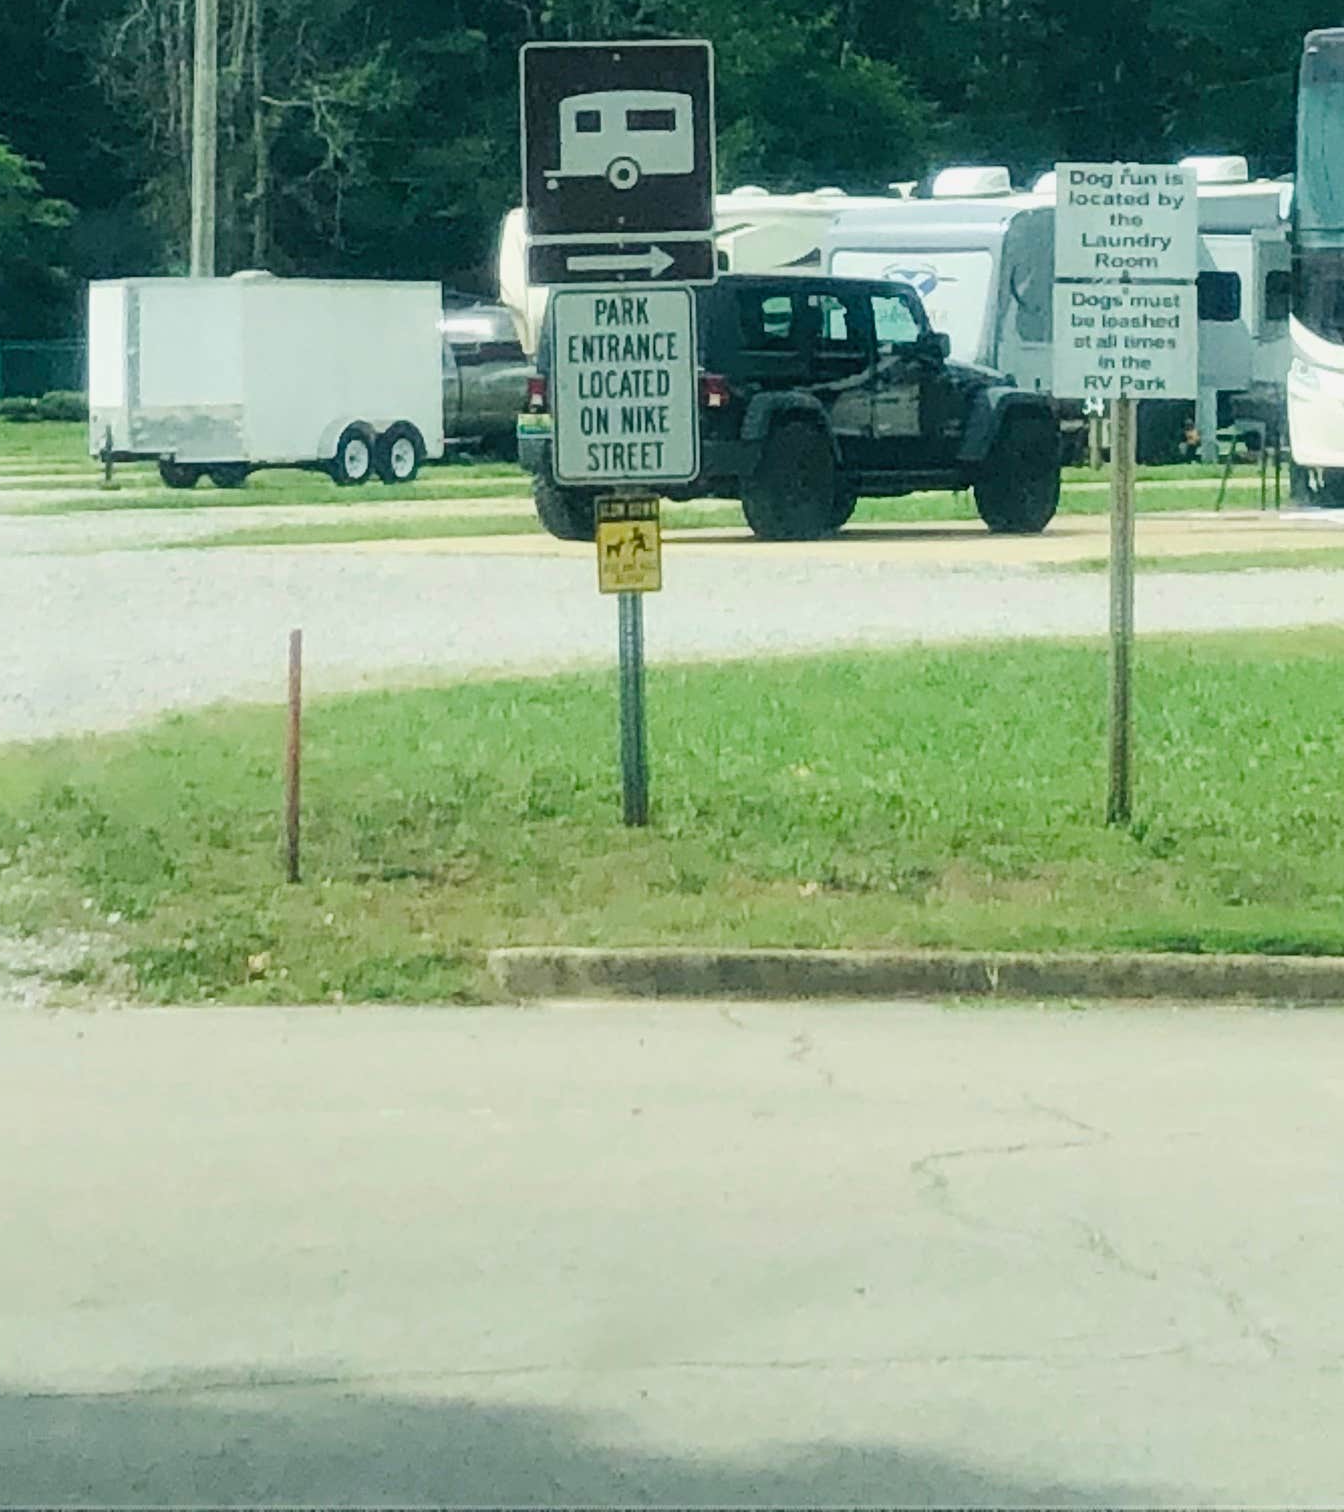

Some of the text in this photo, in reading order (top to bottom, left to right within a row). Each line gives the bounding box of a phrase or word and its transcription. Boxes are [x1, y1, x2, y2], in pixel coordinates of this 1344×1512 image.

[1070, 170, 1184, 188] Dog run is
[1069, 192, 1184, 209] located by
[1110, 213, 1142, 226] the
[1081, 233, 1171, 251] Laundry
[1095, 253, 1158, 268] Room
[1072, 293, 1180, 309] Dogs must
[594, 298, 650, 326] PARK
[1072, 314, 1180, 328] be leashed
[568, 335, 678, 363] ENTRANCE
[1074, 334, 1176, 348] at all times
[1098, 355, 1151, 369] in the
[578, 370, 670, 399] LOCATED
[1085, 375, 1166, 390] RV Park
[580, 407, 609, 436] ON
[621, 407, 670, 435] NIKE
[587, 442, 664, 472] STREET
